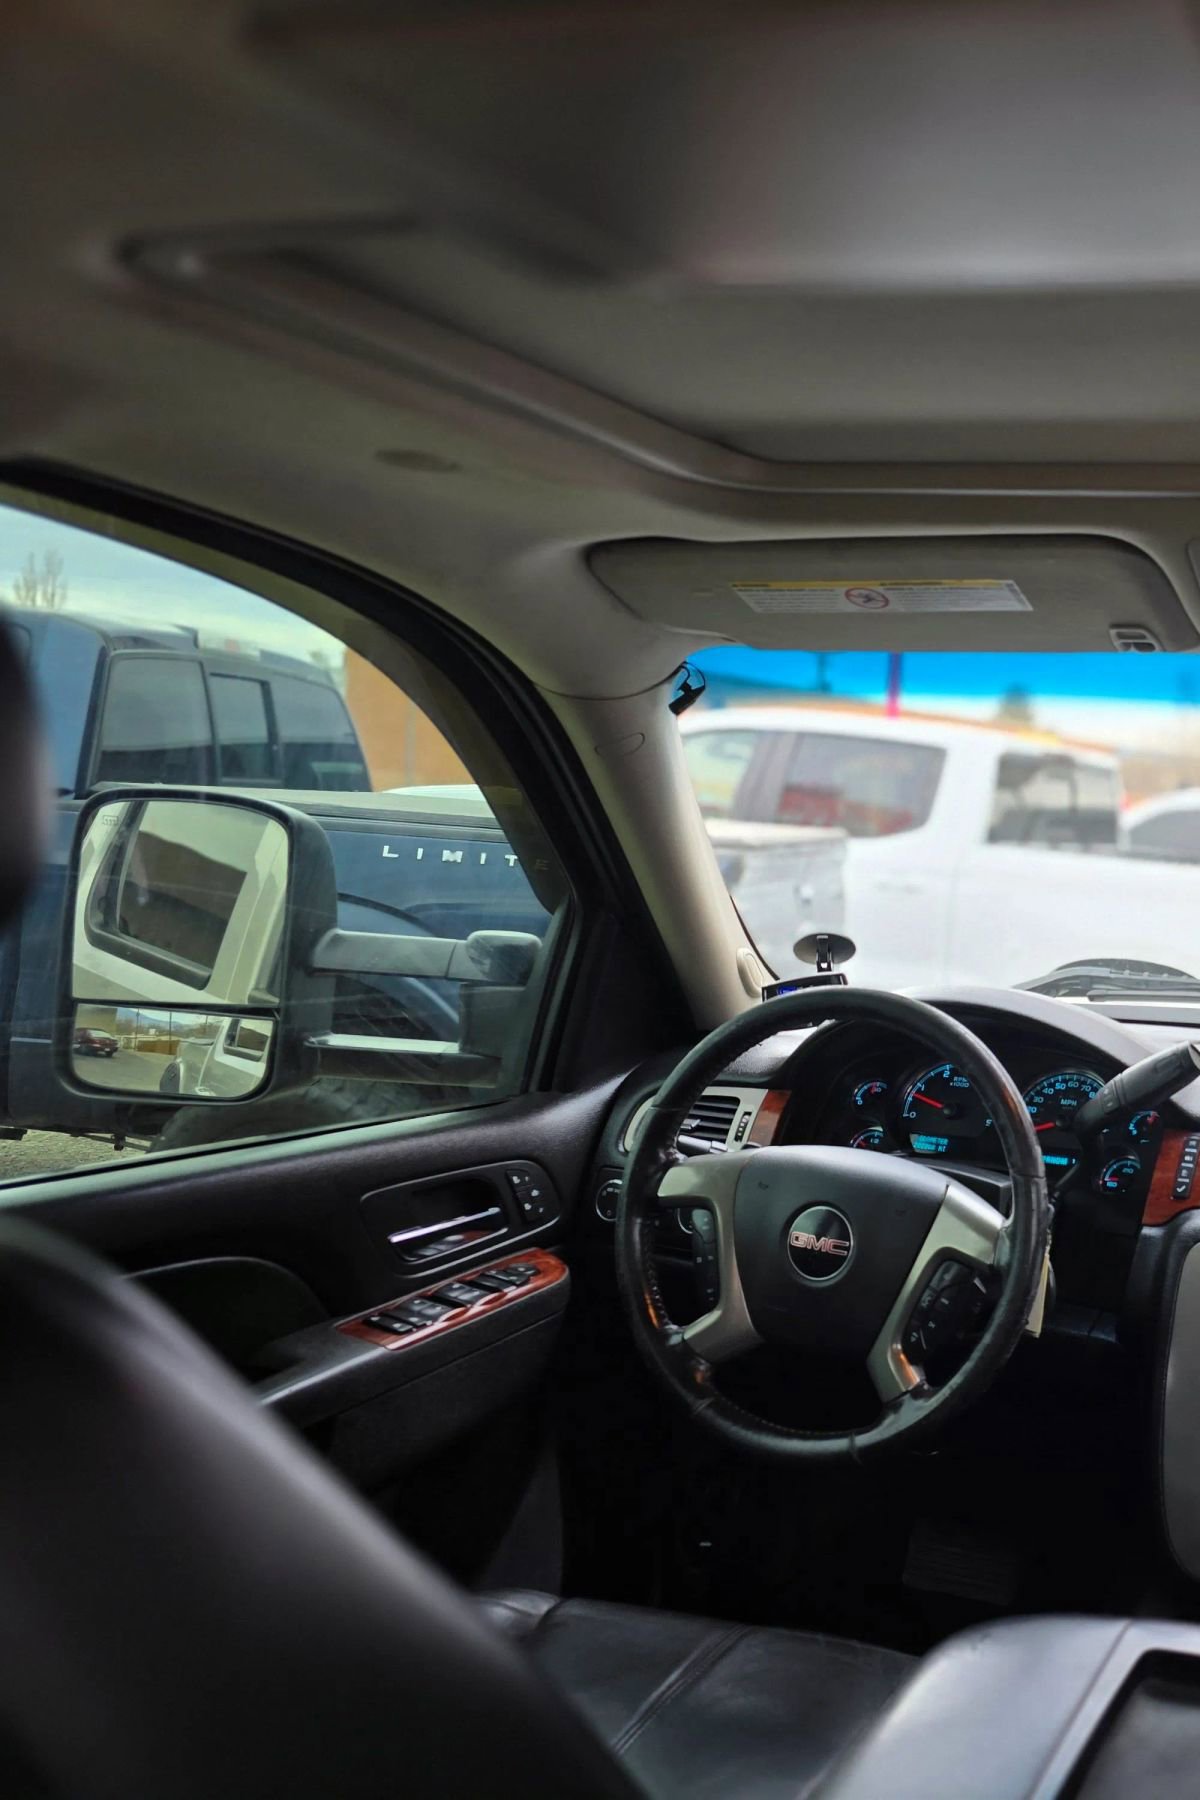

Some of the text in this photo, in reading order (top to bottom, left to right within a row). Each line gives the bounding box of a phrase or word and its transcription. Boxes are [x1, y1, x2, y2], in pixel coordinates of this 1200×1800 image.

[1055, 1082, 1066, 1090] 50
[1042, 1087, 1054, 1095] 40
[790, 1231, 850, 1256] GMC
